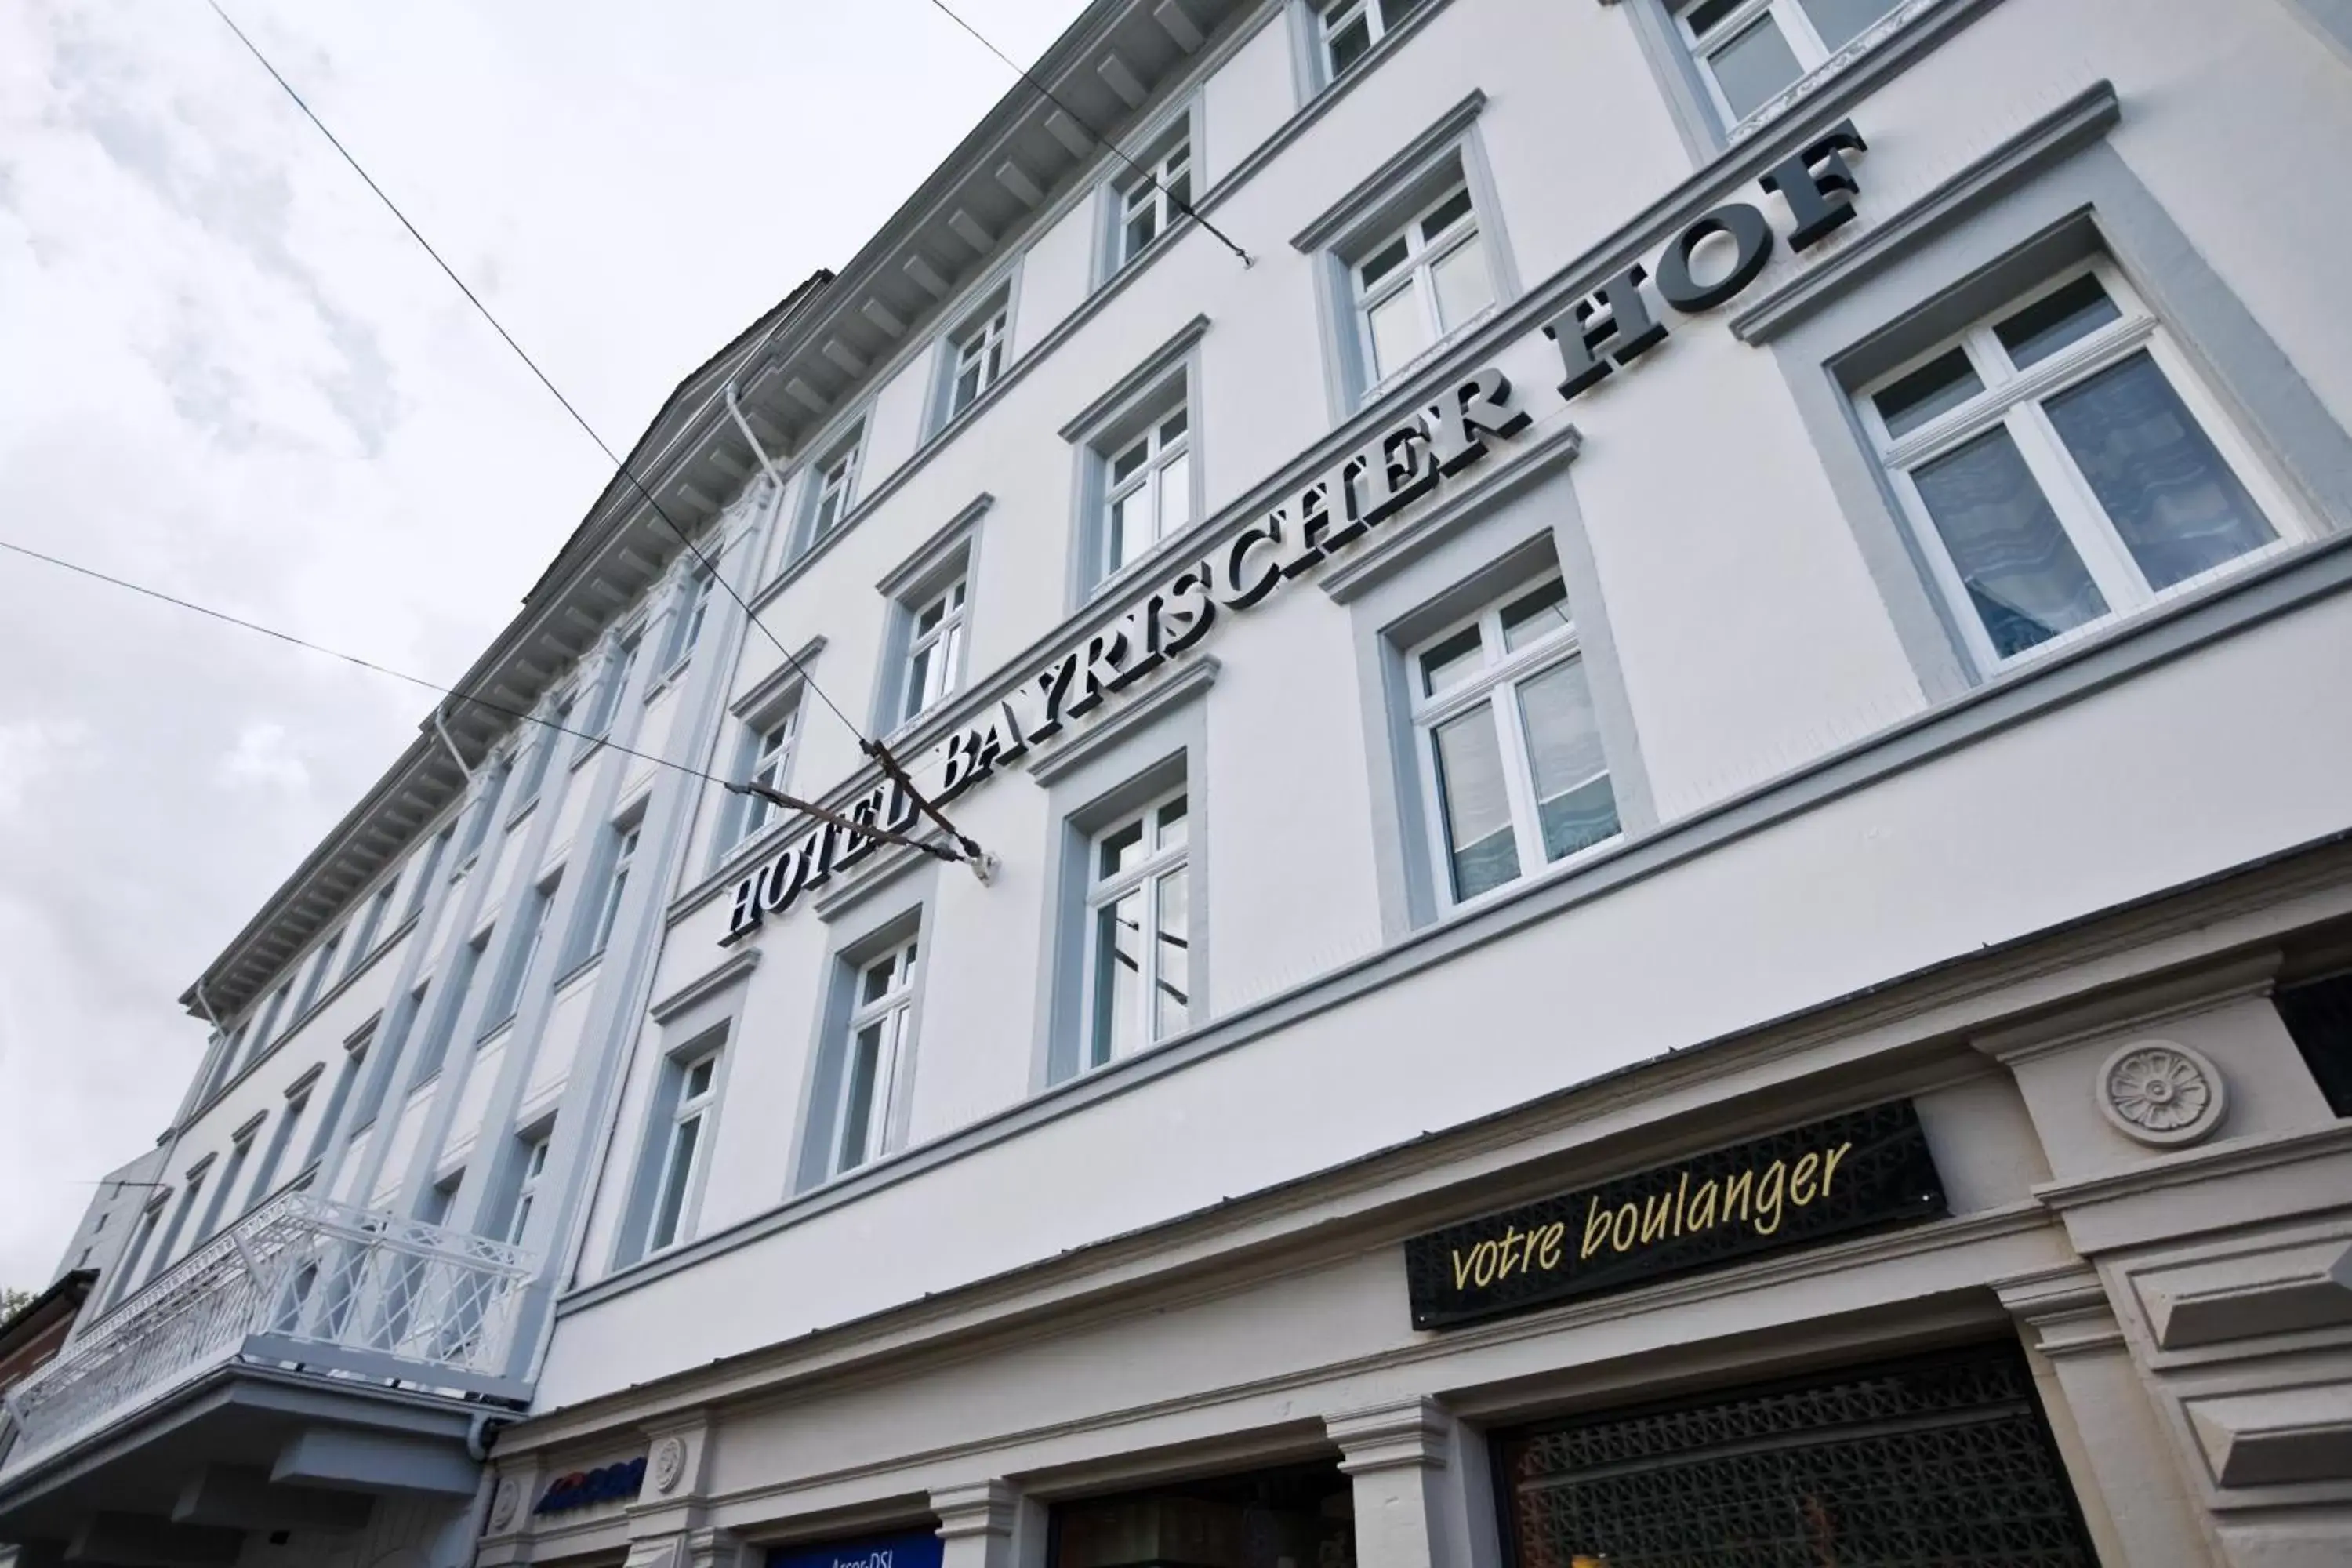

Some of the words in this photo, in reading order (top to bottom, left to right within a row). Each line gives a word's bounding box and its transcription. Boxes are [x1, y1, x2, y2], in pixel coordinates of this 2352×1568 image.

[717, 776, 922, 947] HOTEL
[928, 367, 1533, 808] BAYRISCHER
[1541, 118, 1868, 401] HOF
[1452, 1221, 1565, 1290] votre
[1580, 1142, 1852, 1259] boulanger
